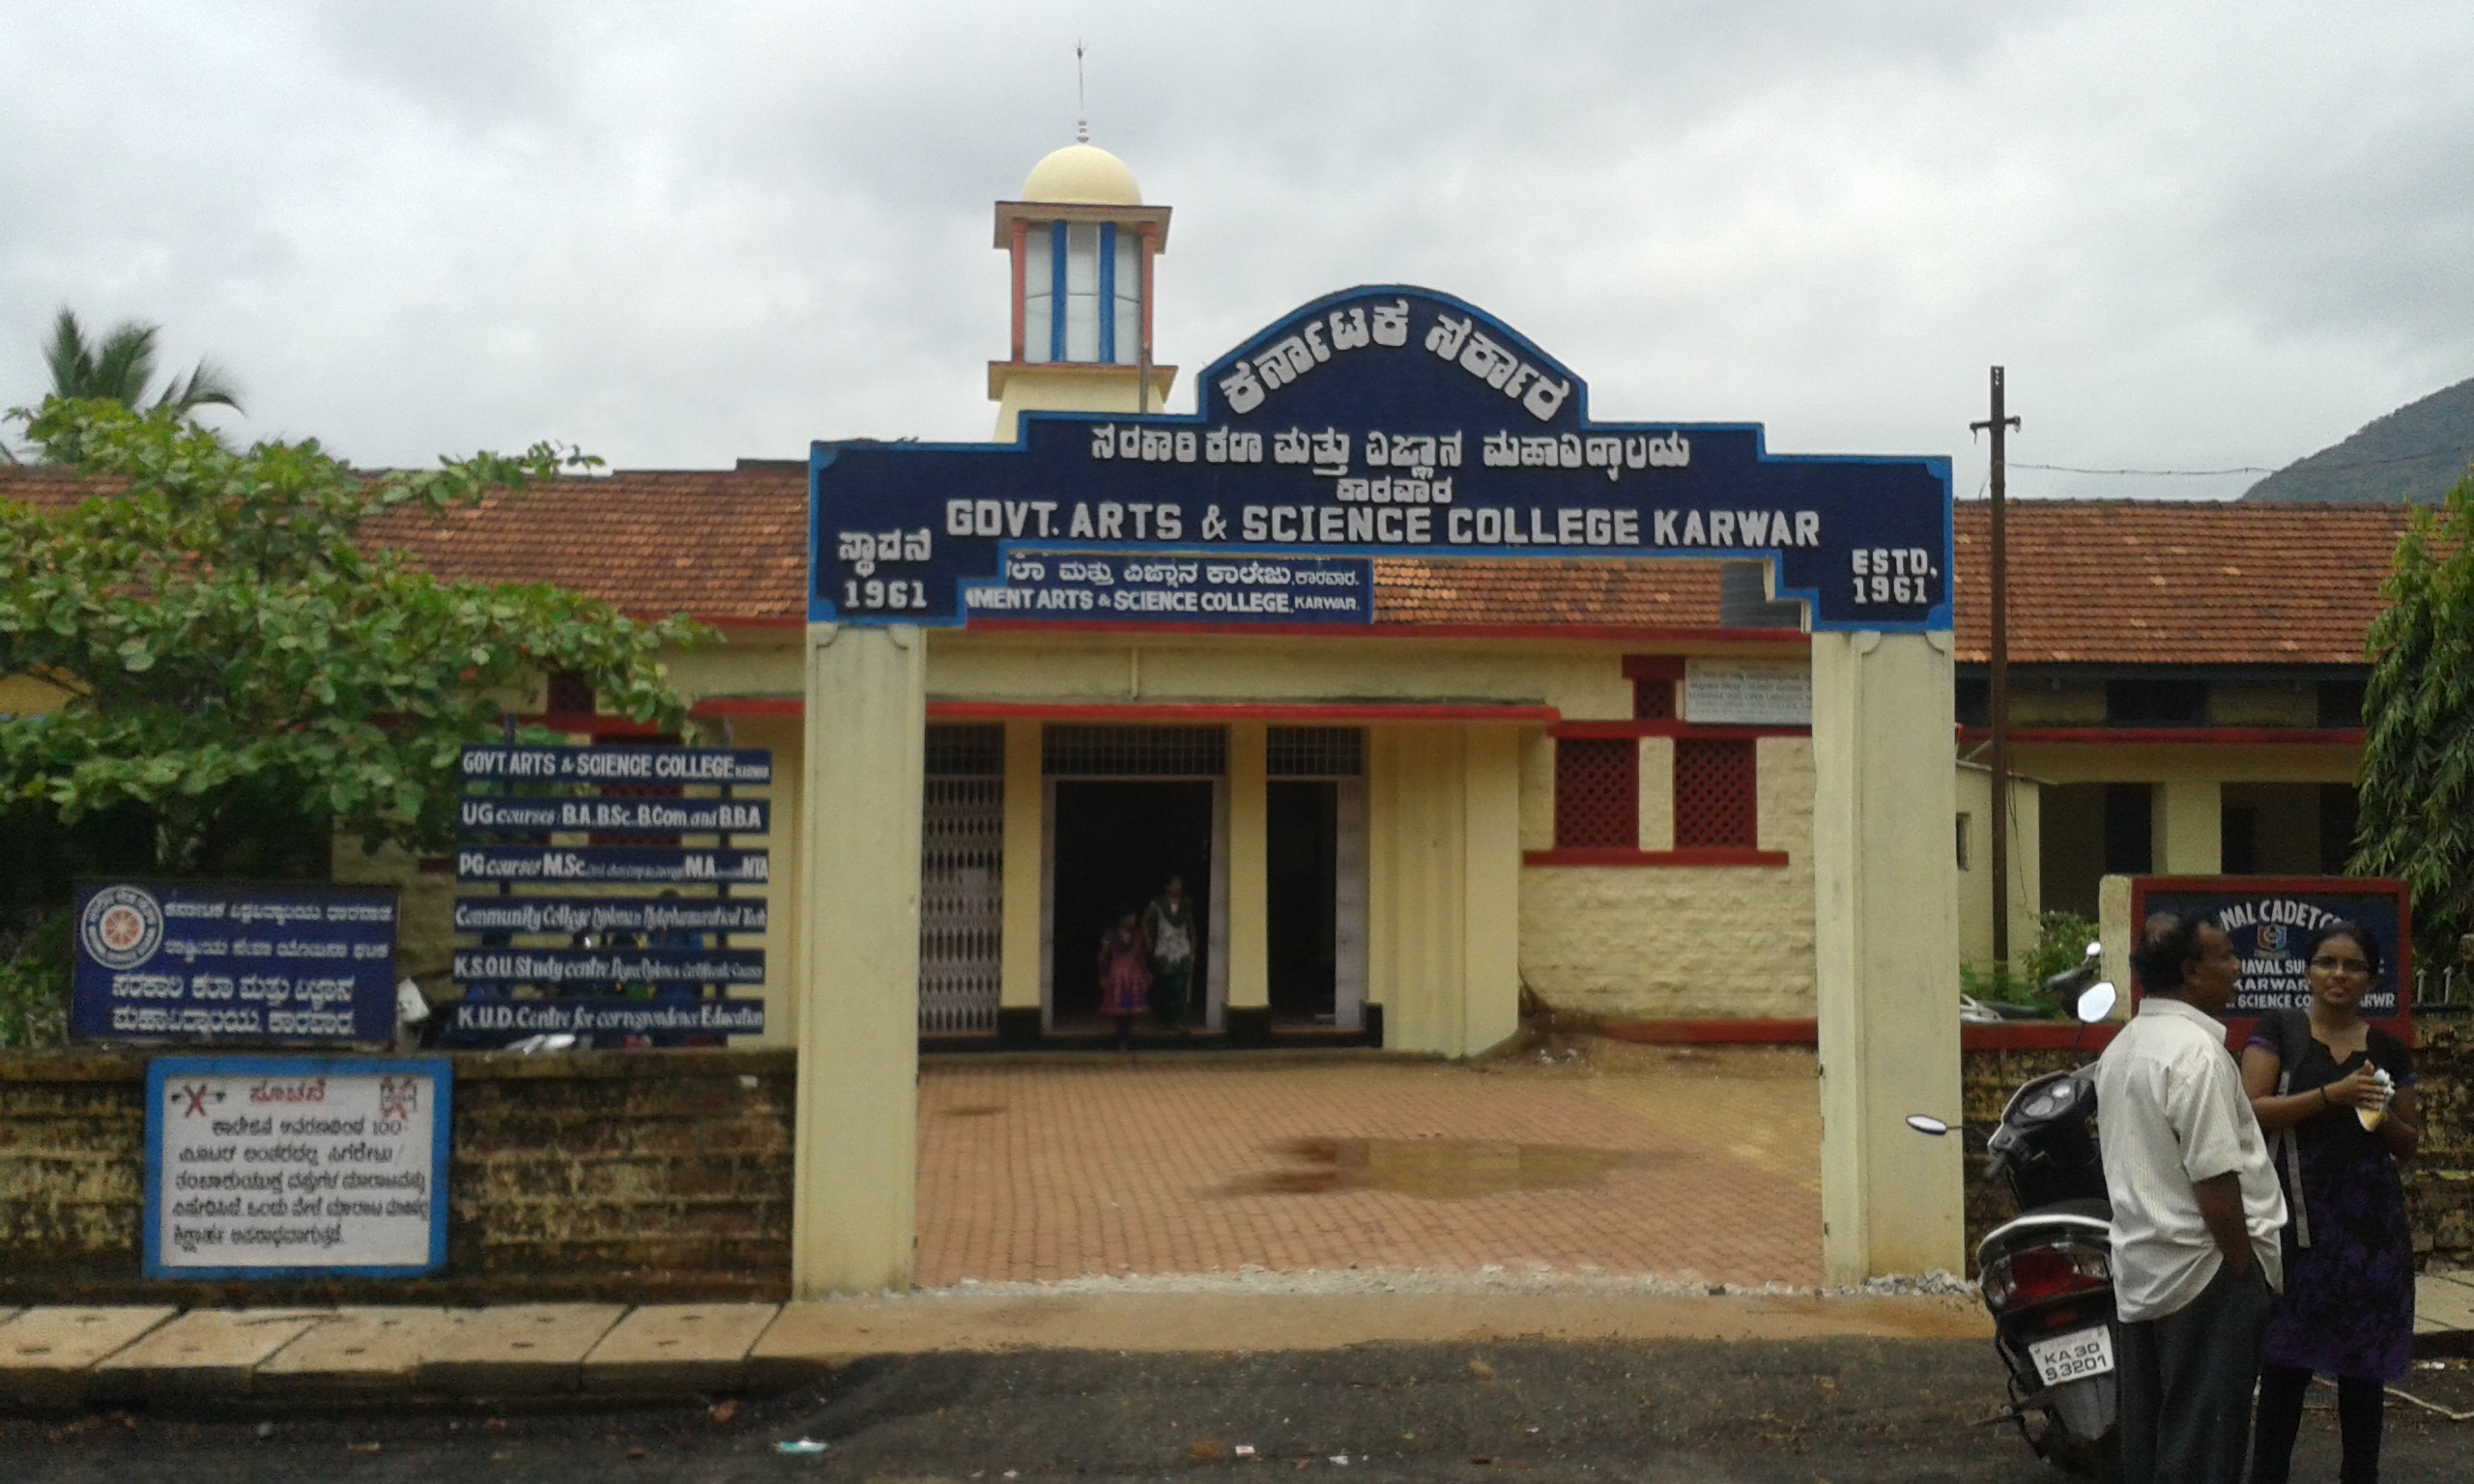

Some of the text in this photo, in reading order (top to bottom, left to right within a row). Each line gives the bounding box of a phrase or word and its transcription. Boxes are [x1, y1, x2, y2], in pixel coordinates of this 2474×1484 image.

[1220, 300, 1571, 422] ಕರ್ನಾಟಕ ಸರ್ಕಾರ
[1092, 425, 1197, 462] ಸರಕಾರಿ
[1274, 426, 1350, 474] ಮತ್ತು
[1366, 430, 1463, 477] ವಿಜ್ಞಾನ
[1483, 431, 1690, 481] ಮಹಾವಿದ್ಯಾಲಯ
[1338, 477, 1453, 503] ಕಾರವಾರ
[946, 499, 1821, 548] GOVT. ARTS & SCIENCE COLLEGE KARWAR
[1006, 560, 1045, 582] ಲಾ
[1058, 561, 1114, 585] ಮತ್ತು
[1124, 562, 1198, 588] ವಿಜ್ಞಾನ
[845, 580, 928, 609] 1961
[1036, 588, 1093, 611] ARTS
[1097, 593, 1110, 607] &
[1113, 589, 1198, 613] SCIENCE
[1853, 576, 1927, 604] 1961
[509, 752, 556, 777] ARTS
[577, 754, 652, 778] SCIENCE
[655, 756, 734, 779] COLLEGE
[462, 803, 494, 824] UG
[459, 853, 484, 876] PG
[456, 906, 541, 932] Community
[543, 907, 590, 930] College
[2259, 899, 2322, 930] CADET
[515, 956, 562, 981] Study
[2237, 993, 2291, 1009] SCIENCE
[2044, 1342, 2100, 1365] KA 30
[2059, 1355, 2107, 1377] 3201
